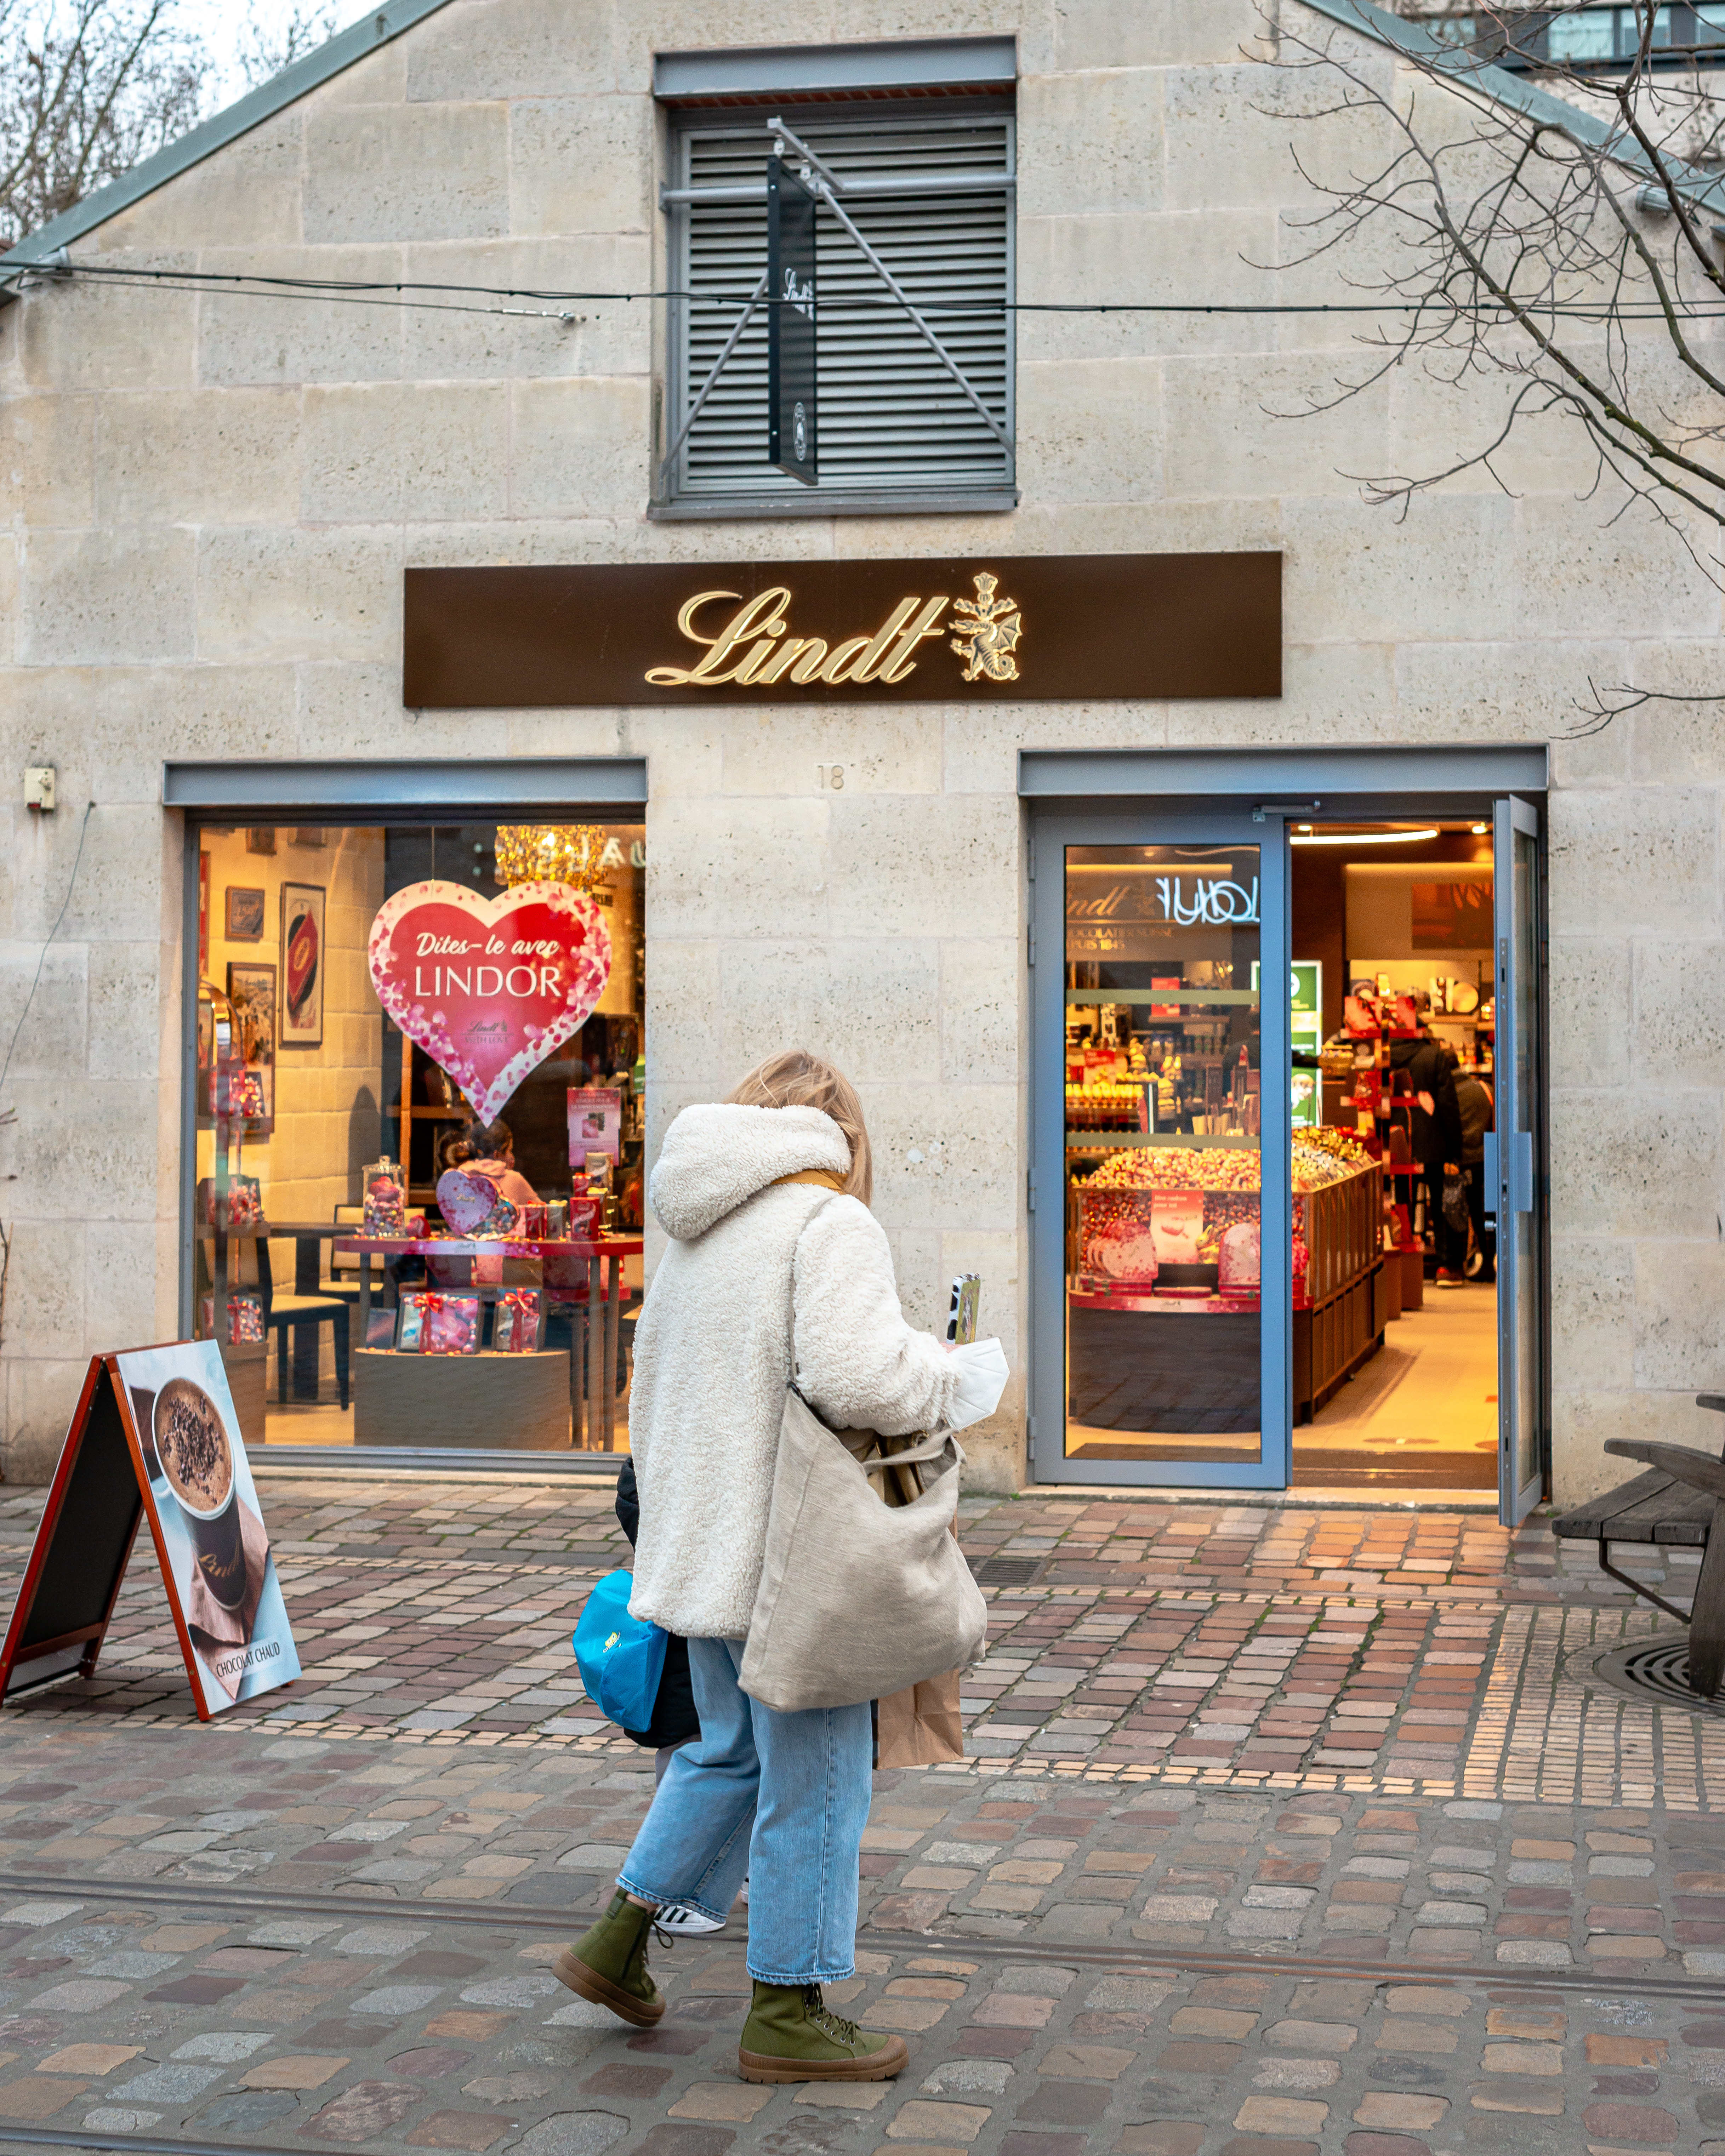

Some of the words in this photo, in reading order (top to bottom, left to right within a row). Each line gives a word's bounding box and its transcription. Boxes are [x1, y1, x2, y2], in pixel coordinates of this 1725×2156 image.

[644, 587, 950, 685] Lindt
[817, 765, 844, 789] 18
[511, 939, 560, 956] avec
[415, 965, 563, 998] LINDOR
[216, 1651, 254, 1677] CHOCOLAT
[255, 1642, 280, 1662] CHAUD
